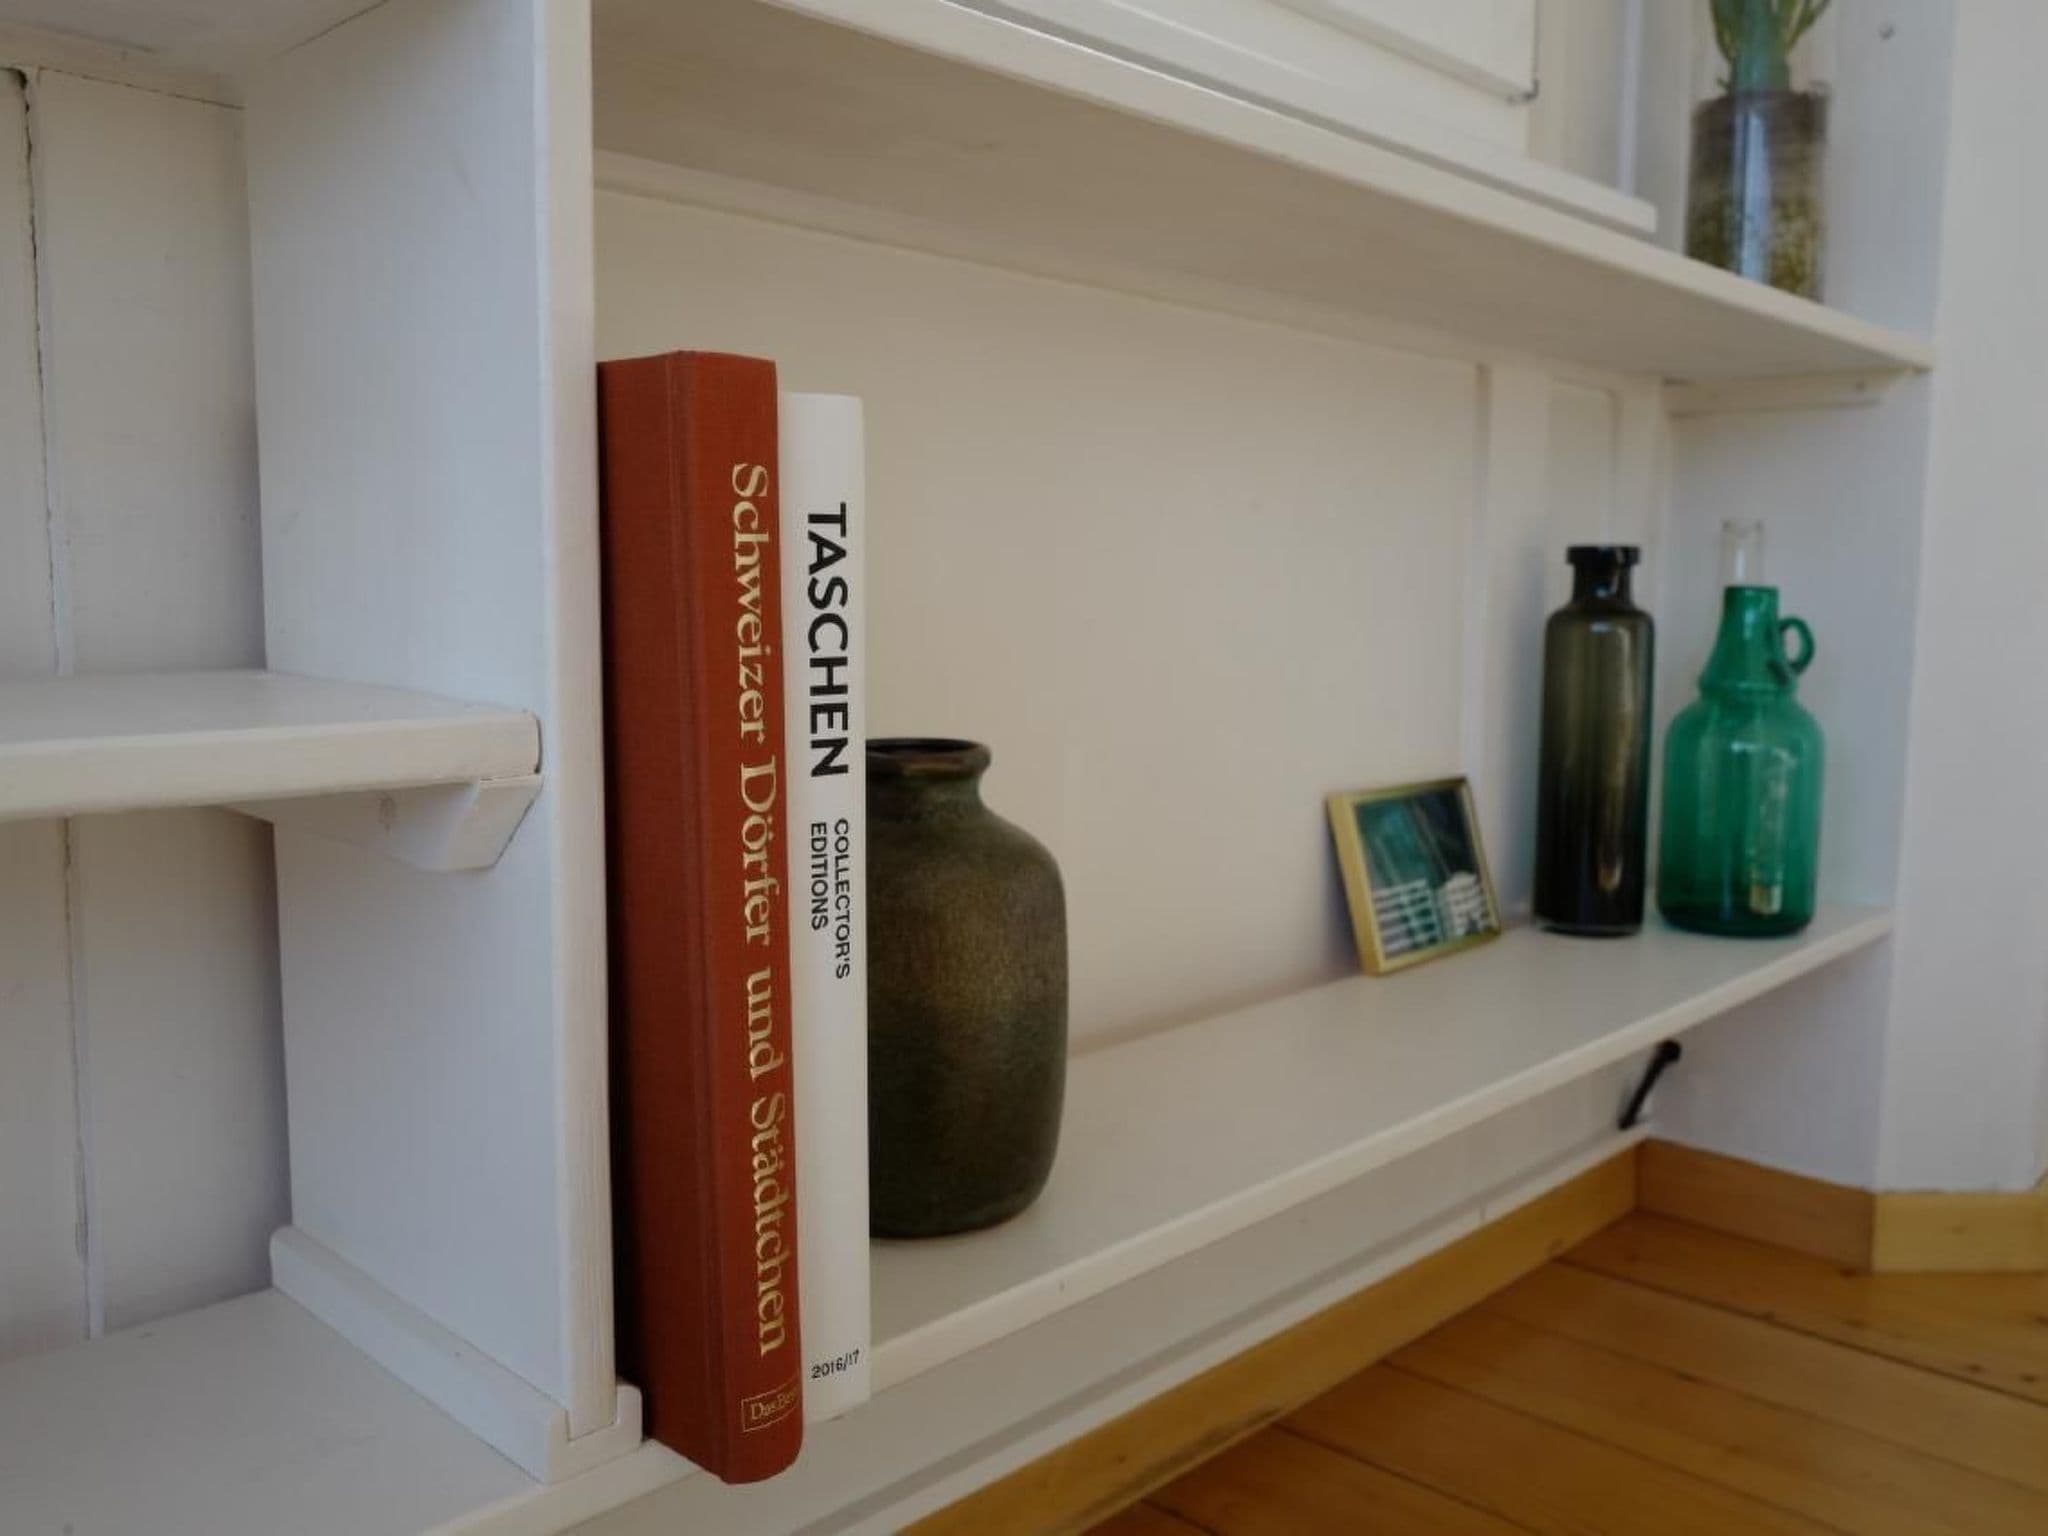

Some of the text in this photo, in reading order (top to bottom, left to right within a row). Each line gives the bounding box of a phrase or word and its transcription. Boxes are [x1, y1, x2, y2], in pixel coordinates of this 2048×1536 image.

[809, 502, 849, 777] TASCHEN
[732, 463, 790, 1358] Schweizer Dörfer und Städtchen
[811, 823, 829, 930] EDITIONS
[833, 818, 851, 979] COLLECTOR'S
[811, 1349, 860, 1379] 2016/17
